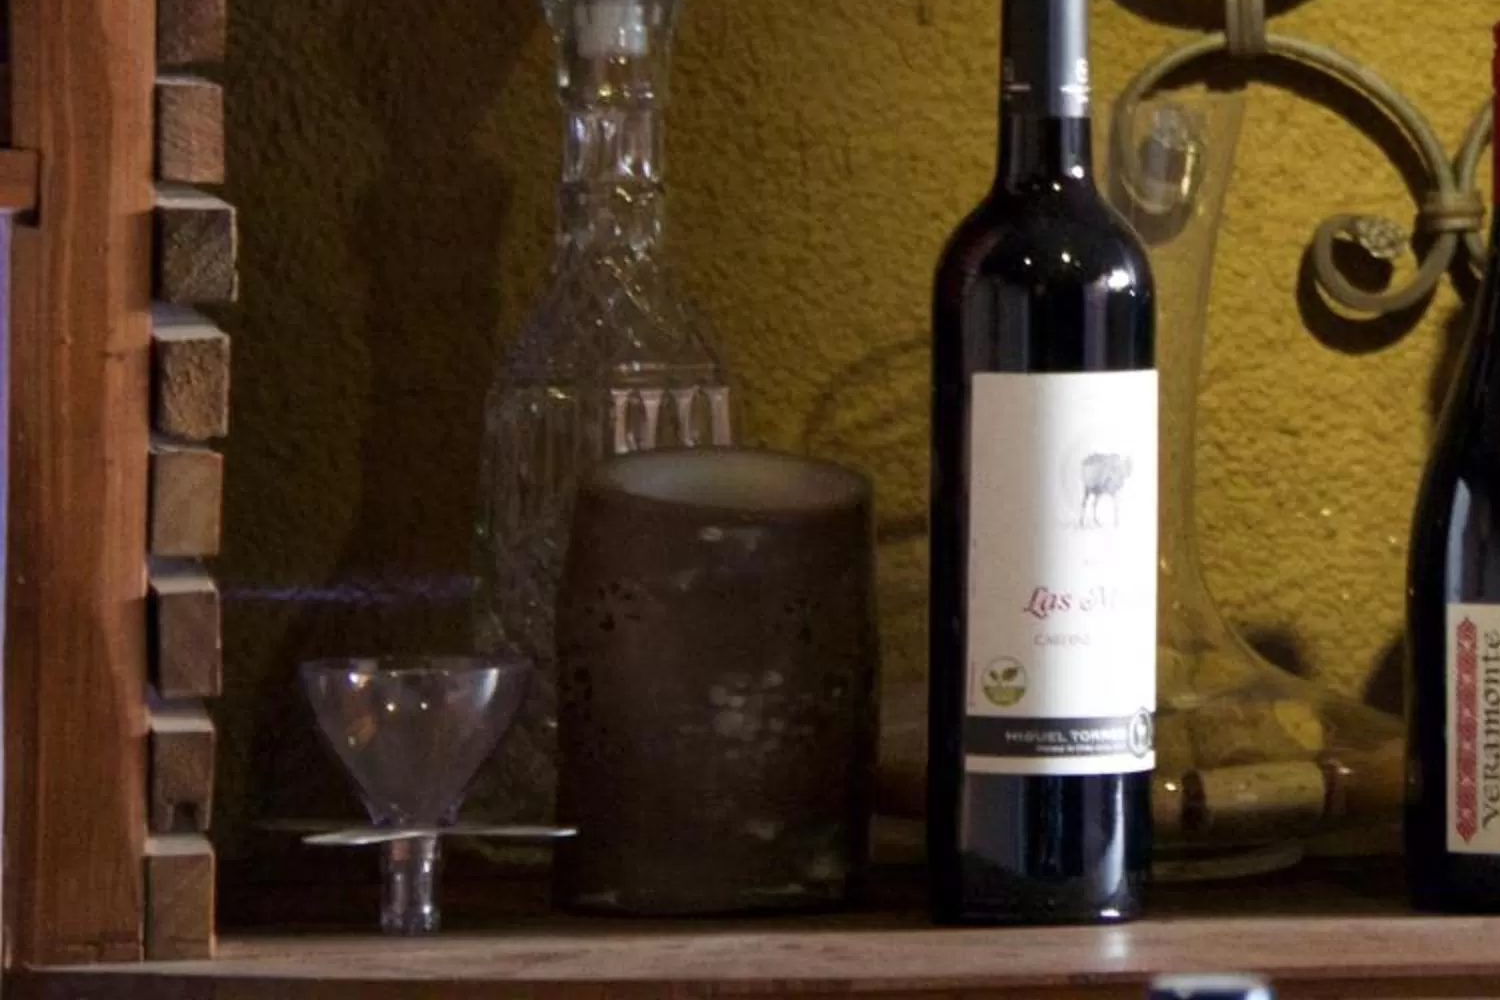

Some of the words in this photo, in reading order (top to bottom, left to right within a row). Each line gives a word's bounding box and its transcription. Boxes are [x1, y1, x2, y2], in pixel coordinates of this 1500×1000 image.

[1023, 585, 1073, 620] Las
[1004, 729, 1066, 744] MIGUEL
[1068, 728, 1127, 743] TOR
